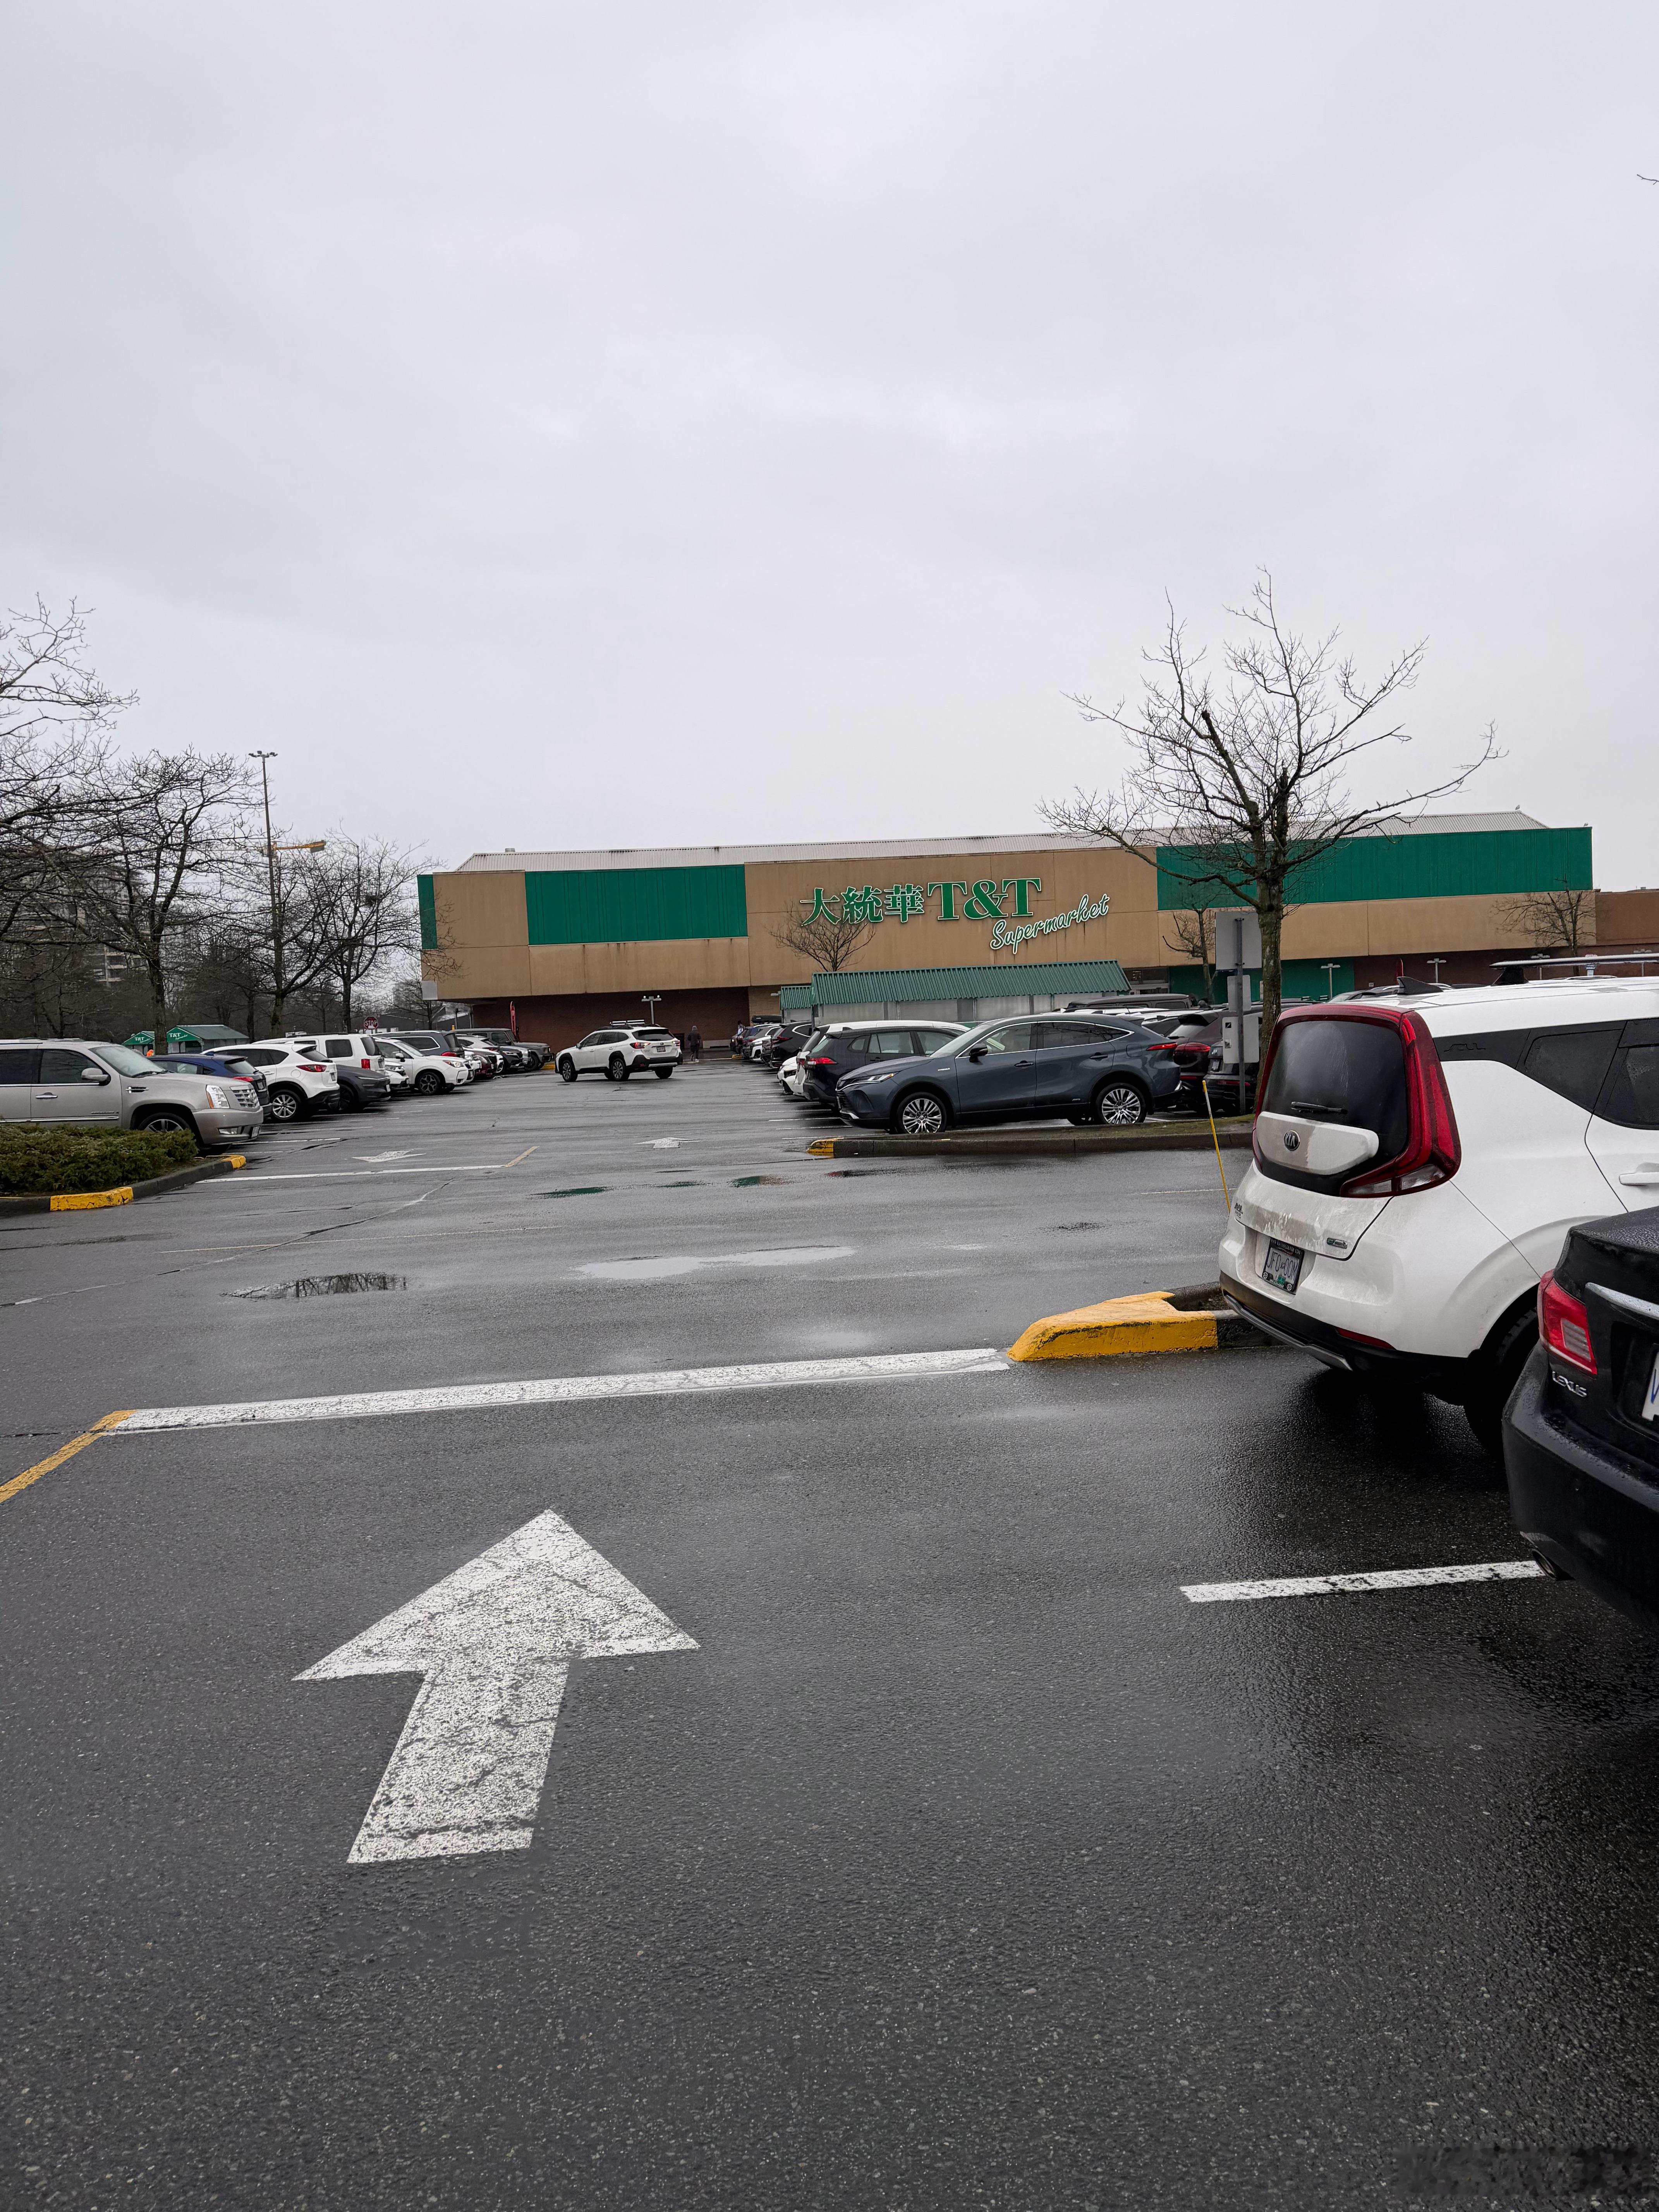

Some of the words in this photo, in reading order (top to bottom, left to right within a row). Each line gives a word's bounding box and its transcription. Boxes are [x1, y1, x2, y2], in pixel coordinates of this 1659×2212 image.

[800, 883, 925, 926] 大統華
[927, 878, 1042, 920] T&T
[990, 893, 1110, 955] Supermarket
[1285, 1132, 1295, 1147] KIA
[1553, 1371, 1587, 1397] LEXUS
